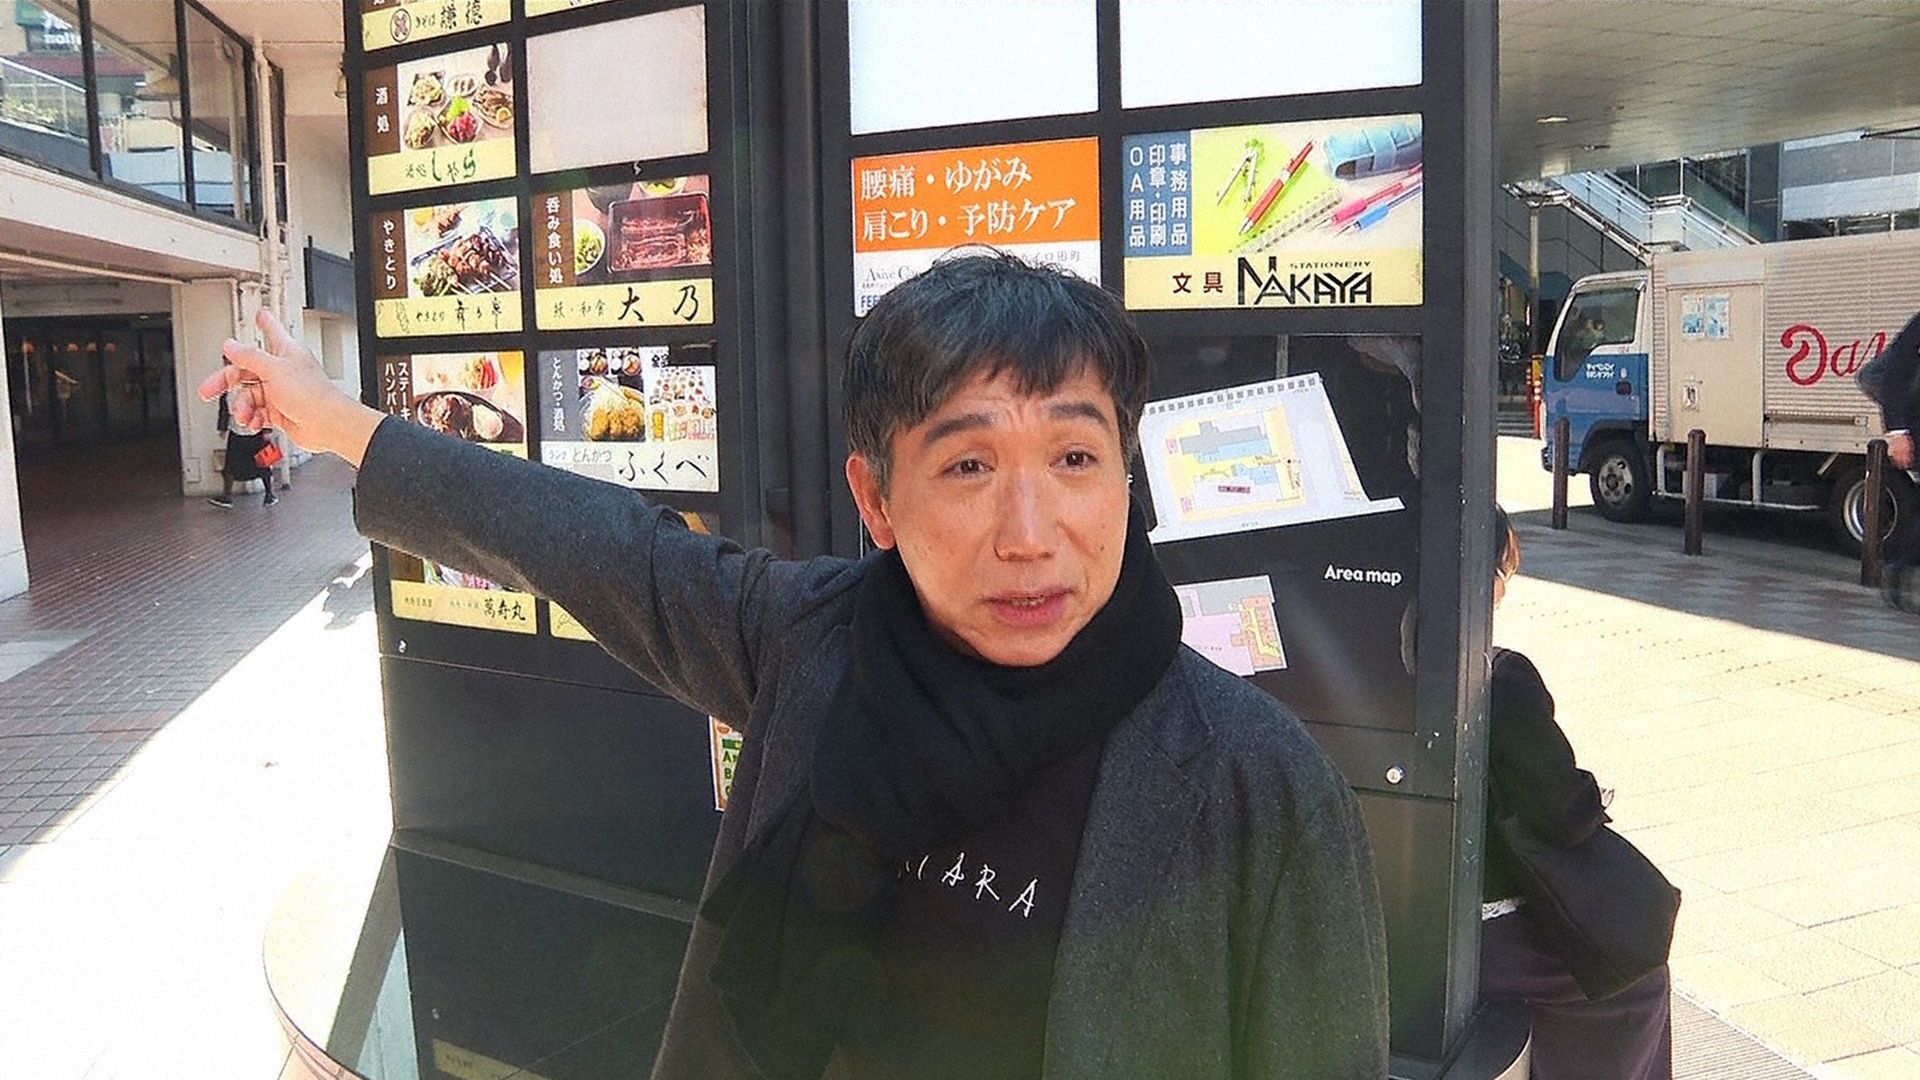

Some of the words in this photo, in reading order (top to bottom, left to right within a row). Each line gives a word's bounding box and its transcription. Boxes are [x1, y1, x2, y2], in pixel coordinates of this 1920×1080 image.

[861, 156, 1032, 200] 腰痛・ゆがみ
[1129, 146, 1146, 248] OA用品
[1149, 144, 1167, 247] 印章・印刷
[1170, 143, 1188, 246] 事務用品
[546, 196, 563, 284] 呑み食い処
[862, 197, 1076, 242] 肩こり・予防ケア
[382, 220, 396, 290] やきとり
[1290, 260, 1371, 268] STATIONERY
[1172, 272, 1224, 294] 文具
[1237, 256, 1372, 305] NAKAYA
[398, 362, 412, 421] ステーキ
[619, 451, 709, 485] ふくべ
[1324, 564, 1364, 581] Area
[1366, 567, 1402, 586] map
